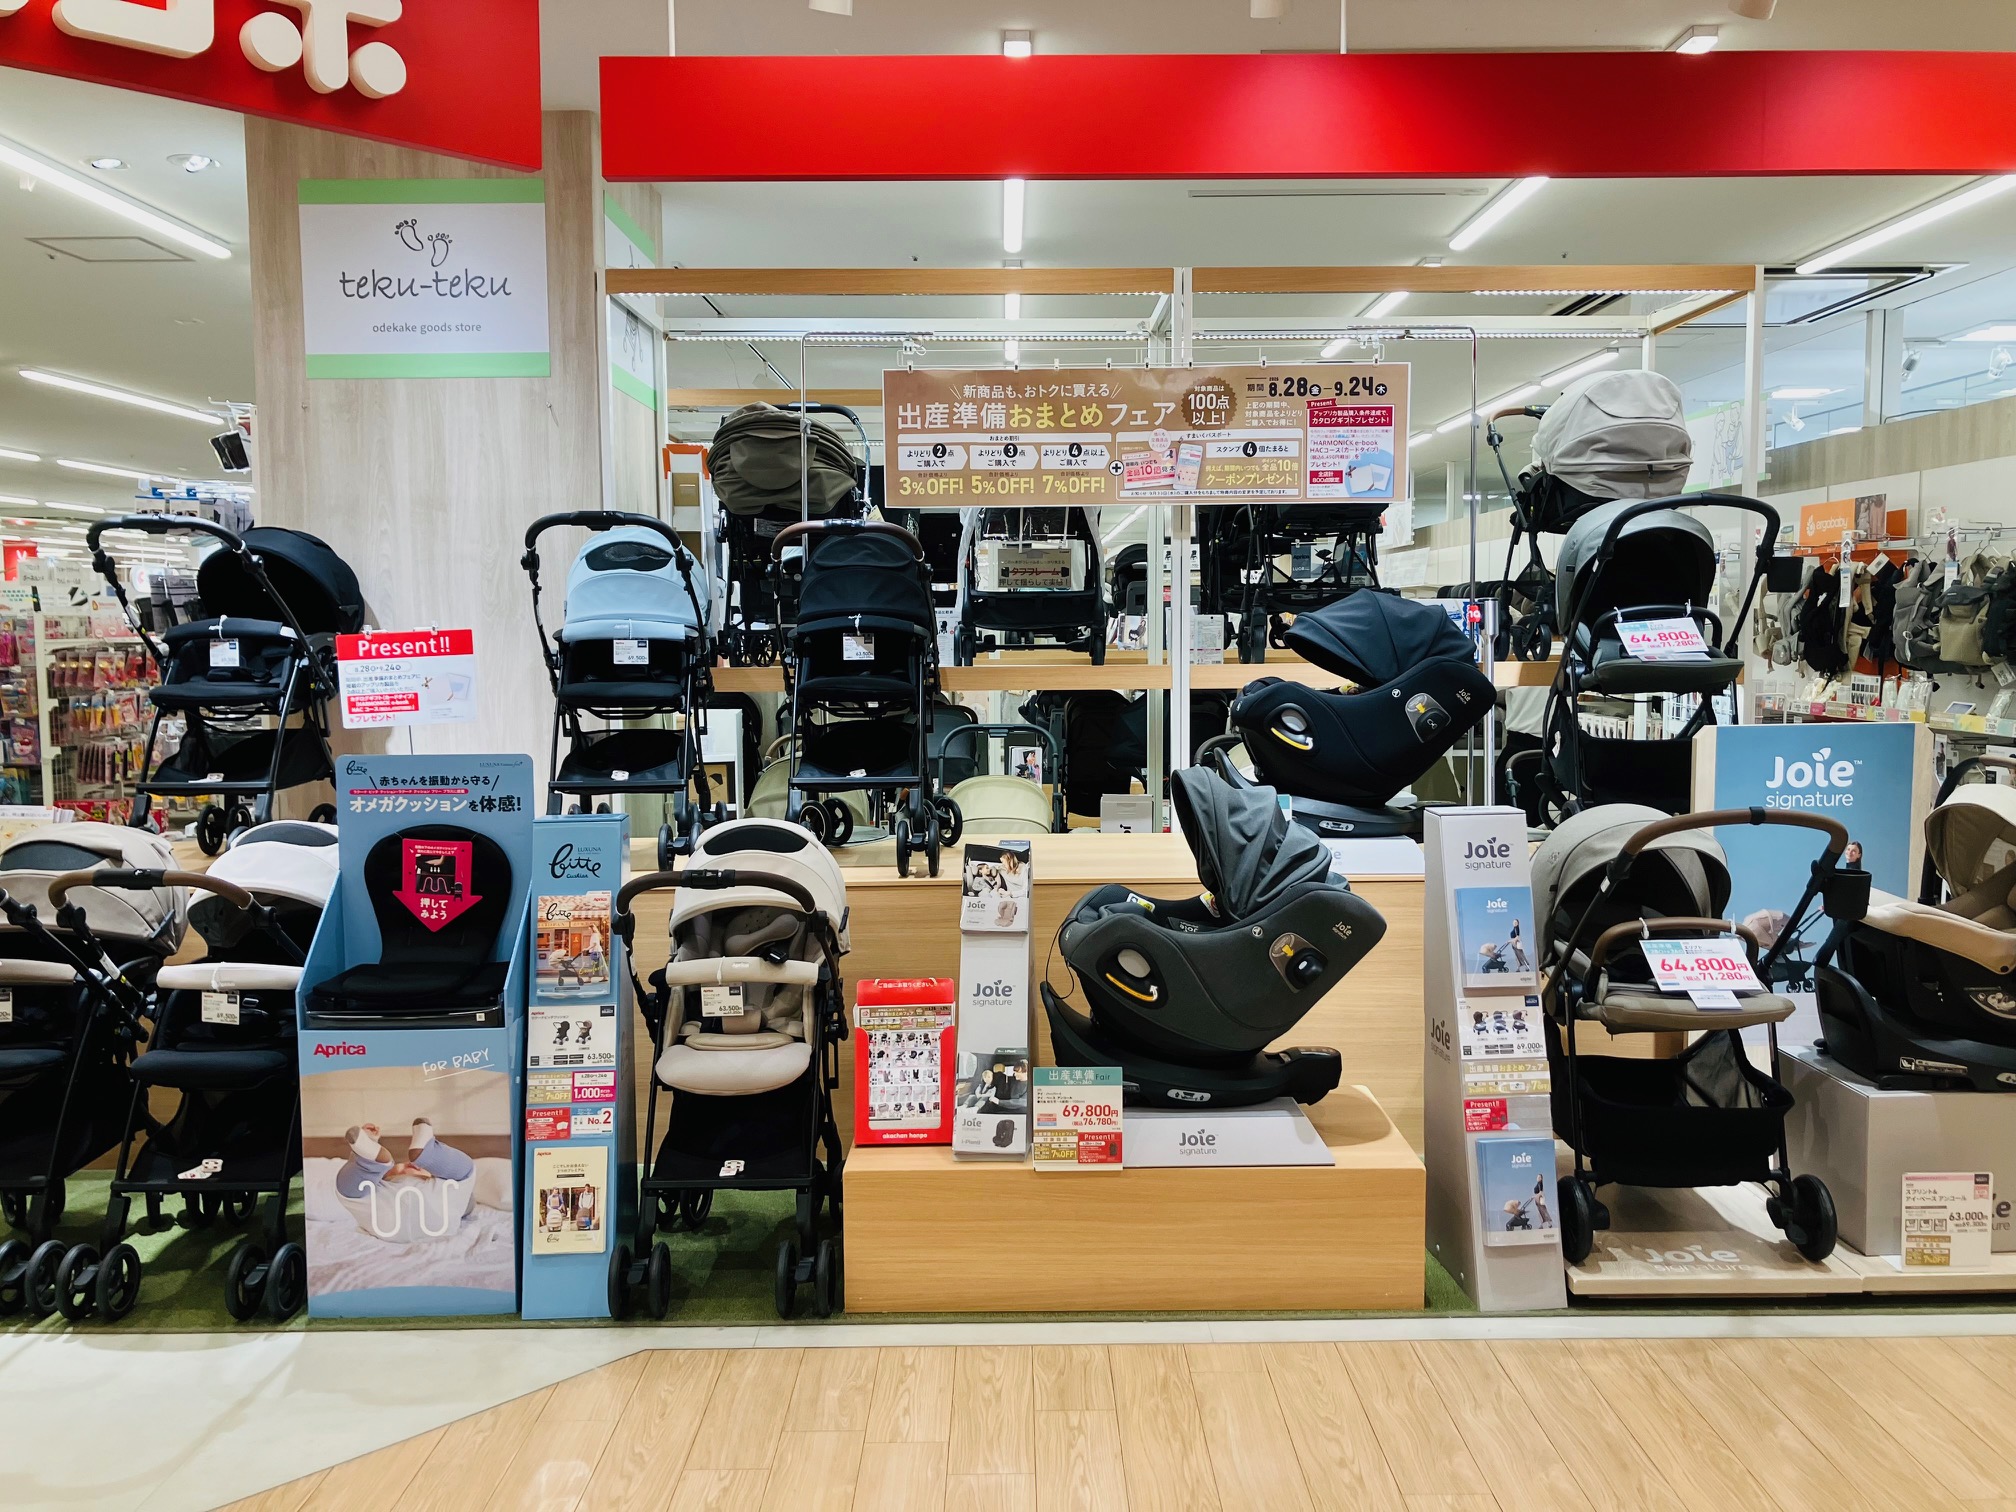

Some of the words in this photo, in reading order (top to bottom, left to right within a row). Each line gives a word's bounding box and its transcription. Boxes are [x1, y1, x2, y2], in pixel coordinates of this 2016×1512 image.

[339, 268, 512, 299] teku-teku
[372, 323, 417, 333] odekake
[420, 322, 452, 334] goods
[455, 323, 482, 332] store
[963, 383, 1110, 399] 新商品も、おトクに買える
[1246, 383, 1265, 392] 期間
[1188, 393, 1230, 410] 100点
[897, 401, 1176, 430] 出産準備おまとめフェア
[1191, 410, 1225, 426] 以上!
[916, 459, 946, 468] ご購入で
[987, 459, 1017, 467] ご購入で
[1059, 459, 1088, 467] ご購入で
[1205, 473, 1299, 487] クーポンプレゼント!
[1816, 516, 1848, 532] ergobaby
[357, 636, 451, 657] Present!!
[379, 775, 491, 787] 赤ちゃんを振動から守る
[349, 794, 522, 813] オメガクッションを体感!
[1765, 791, 1854, 810] signature
[1463, 836, 1511, 860] Joie
[1464, 860, 1512, 872] signature
[420, 897, 449, 908] 押して
[967, 900, 986, 910] Joie
[1485, 897, 1509, 909] Joie
[420, 909, 447, 920] みよう
[972, 979, 1013, 998] Joie
[972, 998, 1013, 1007] signature
[313, 1041, 367, 1058] Aprica
[422, 1059, 447, 1076] FOR
[452, 1048, 490, 1070] BABY
[1469, 1063, 1544, 1073] 出産準備おまとめフェア
[1048, 1069, 1095, 1081] 出産準備
[1095, 1073, 1111, 1081] Fair
[574, 1087, 601, 1099] 1,000
[532, 1109, 563, 1117] Present!!
[1062, 1104, 1119, 1117] 69,800円
[961, 1117, 982, 1128] Joie
[1178, 1129, 1217, 1147] Joie
[1179, 1147, 1218, 1156] signature
[1510, 1152, 1532, 1164] Joie
